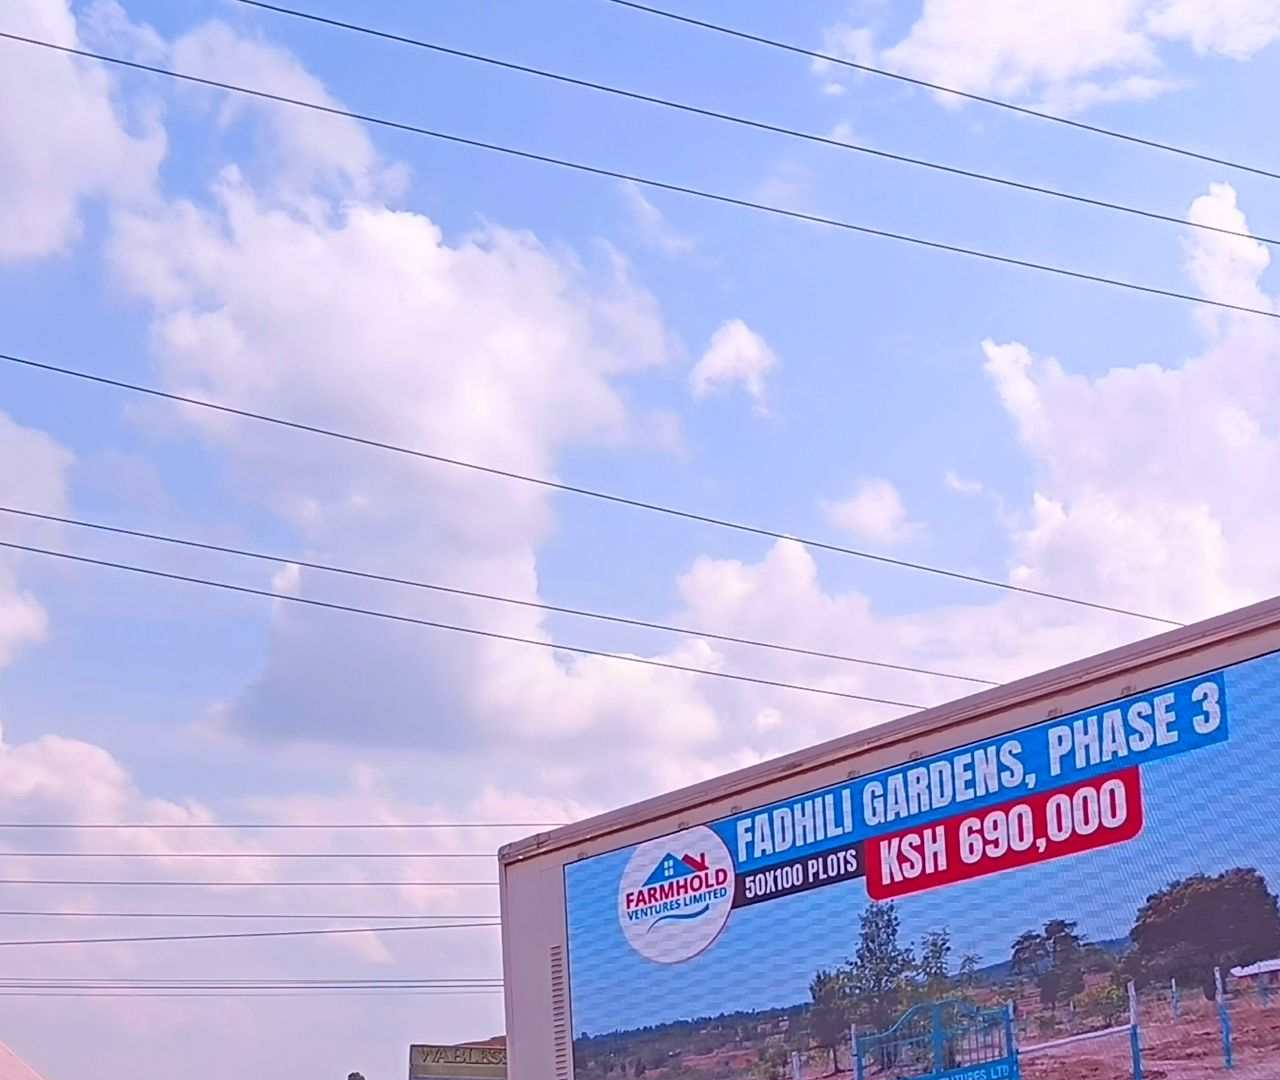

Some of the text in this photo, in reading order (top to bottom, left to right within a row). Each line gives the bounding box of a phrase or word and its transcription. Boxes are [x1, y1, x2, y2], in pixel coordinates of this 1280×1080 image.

[736, 681, 1222, 863] FADHILI GARDENS, PHASE 3
[879, 778, 1128, 885] KSH 690,000
[625, 867, 728, 910] FARMHOLD
[745, 848, 858, 899] 50X100 PLOTS
[627, 886, 728, 921] VENTURES LIMITED
[990, 1064, 1010, 1079] LTD
